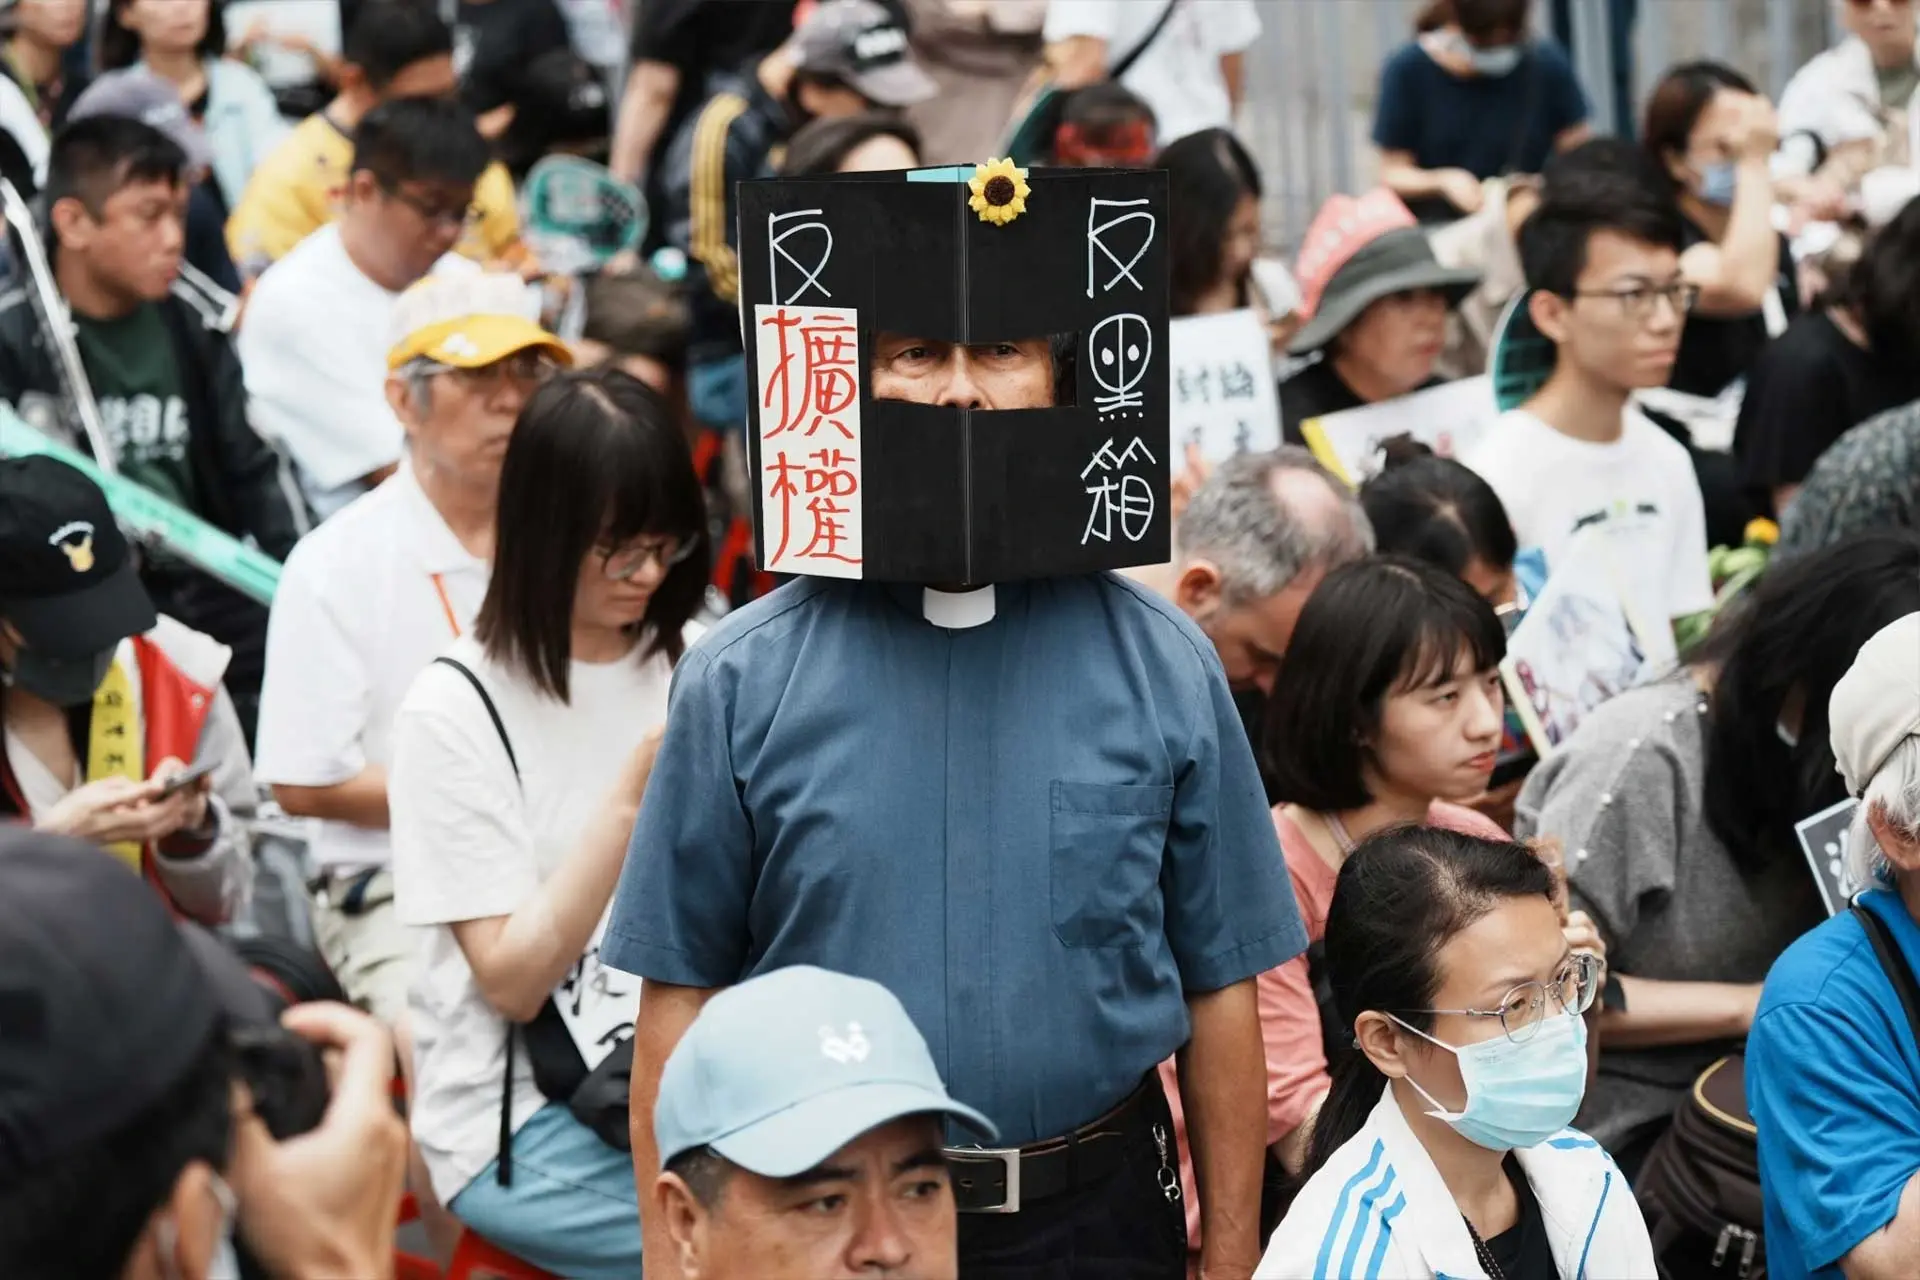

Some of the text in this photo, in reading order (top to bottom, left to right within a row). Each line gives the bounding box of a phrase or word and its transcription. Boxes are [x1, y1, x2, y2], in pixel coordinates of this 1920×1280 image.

[762, 209, 863, 568] 反擴權
[1081, 197, 1156, 545] 反黑箱
